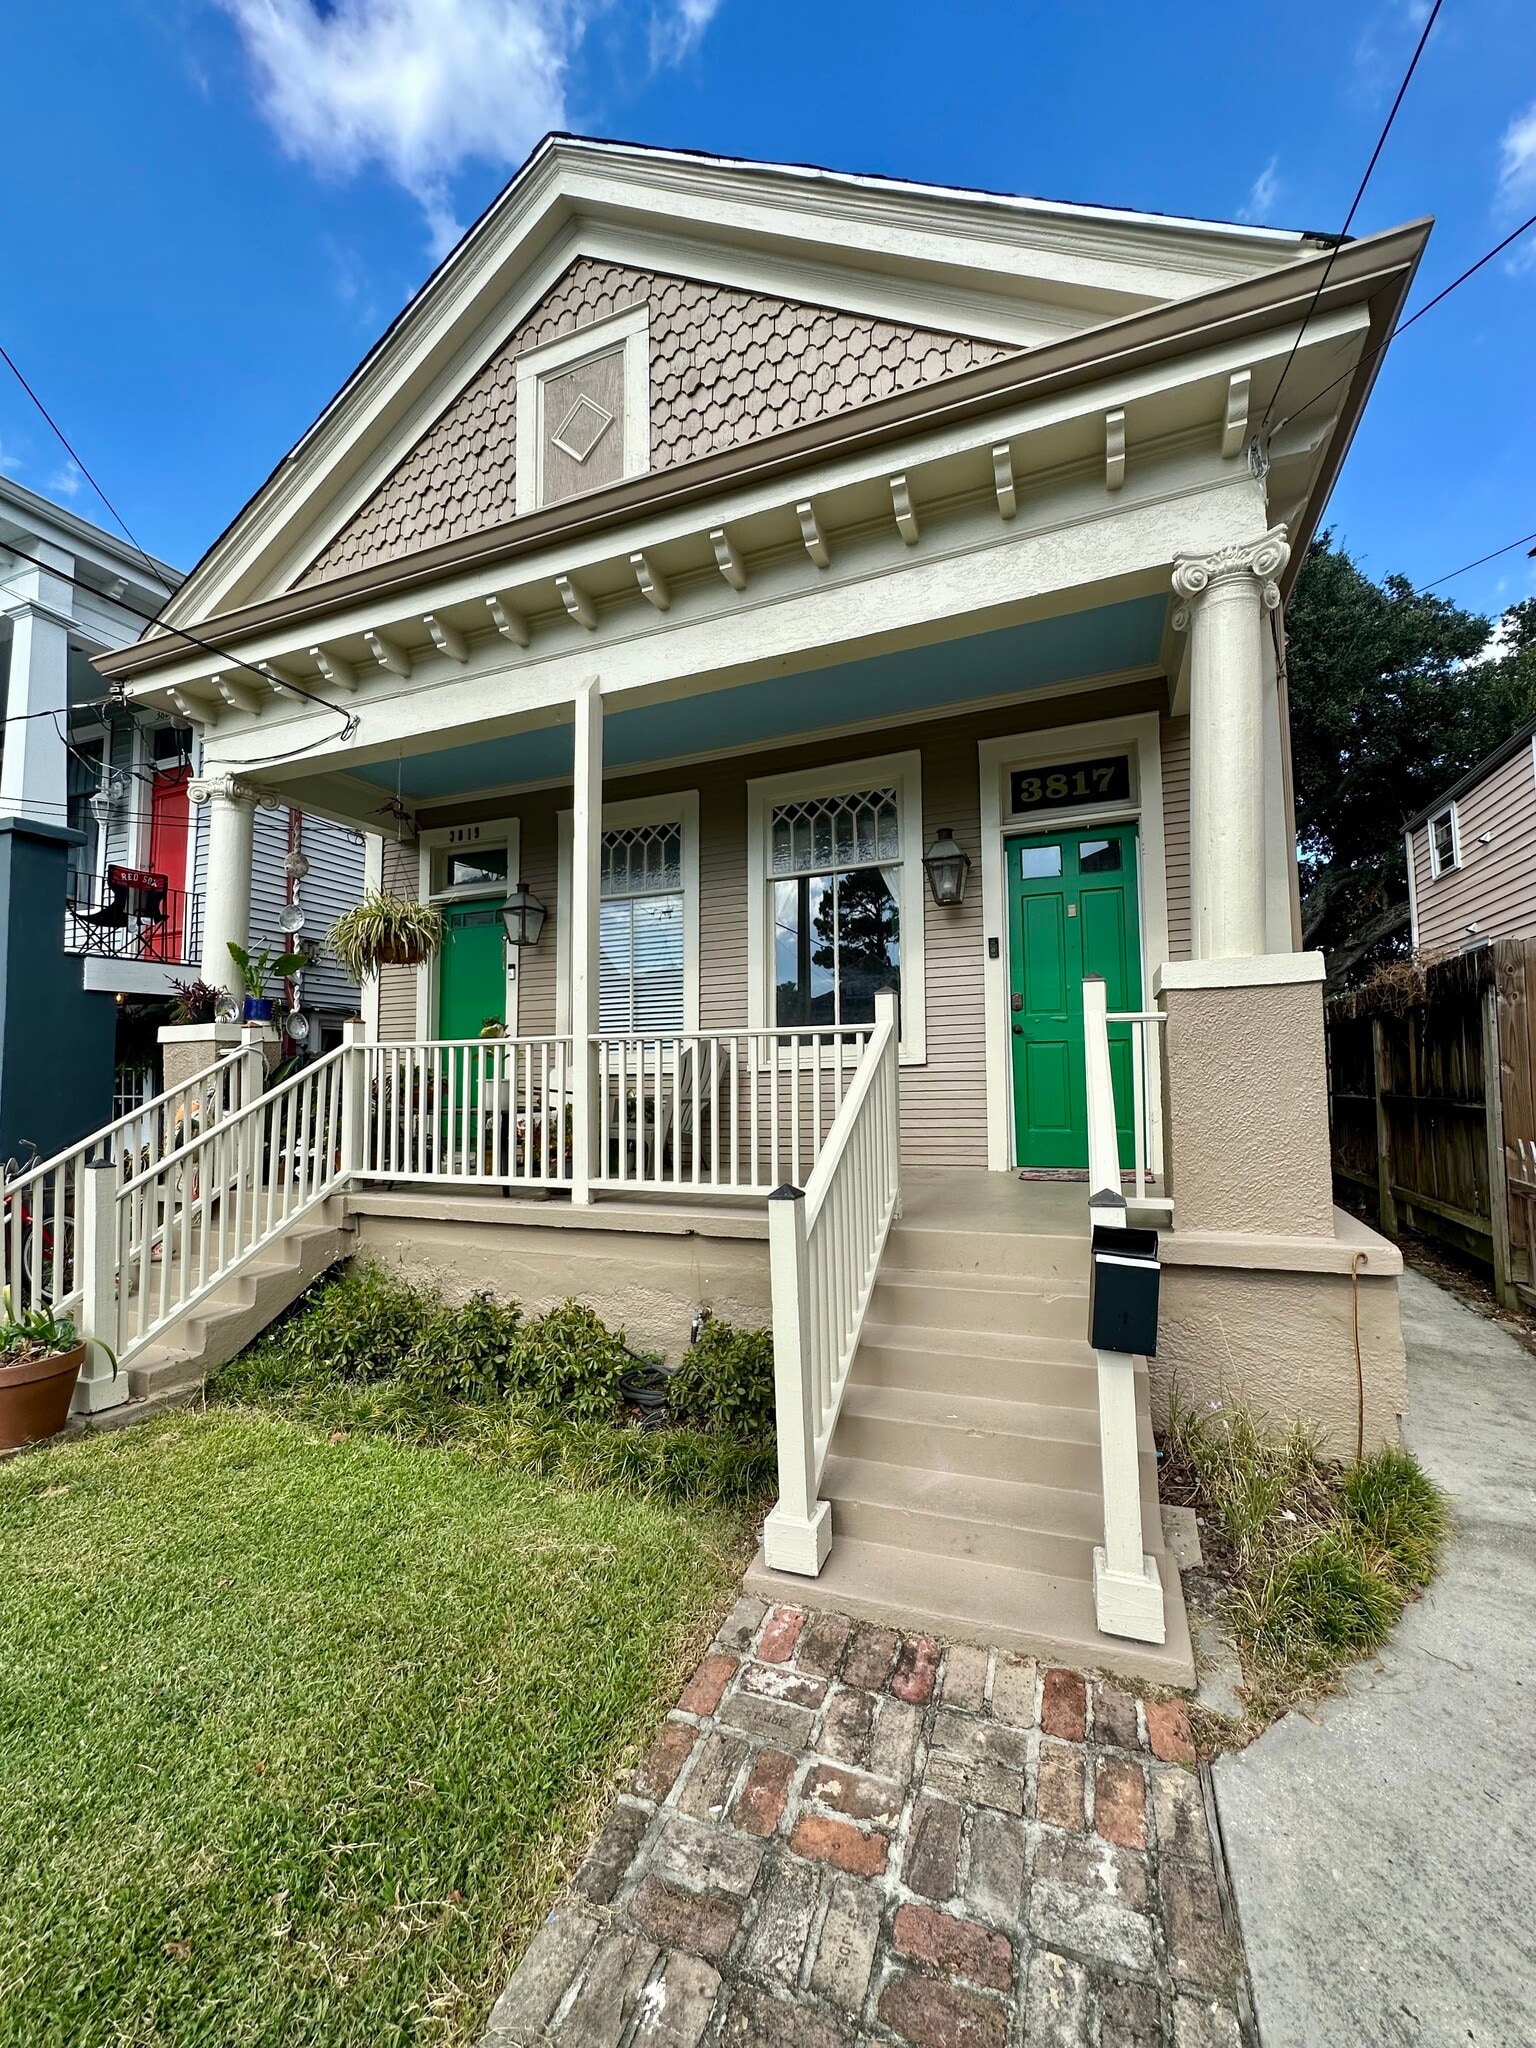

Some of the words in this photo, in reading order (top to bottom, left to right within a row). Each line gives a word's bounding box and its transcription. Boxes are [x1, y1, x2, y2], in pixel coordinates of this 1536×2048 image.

[1020, 766, 1115, 802] 3817
[449, 826, 480, 843] 3819
[121, 873, 139, 882] RED
[142, 875, 158, 887] SOX
